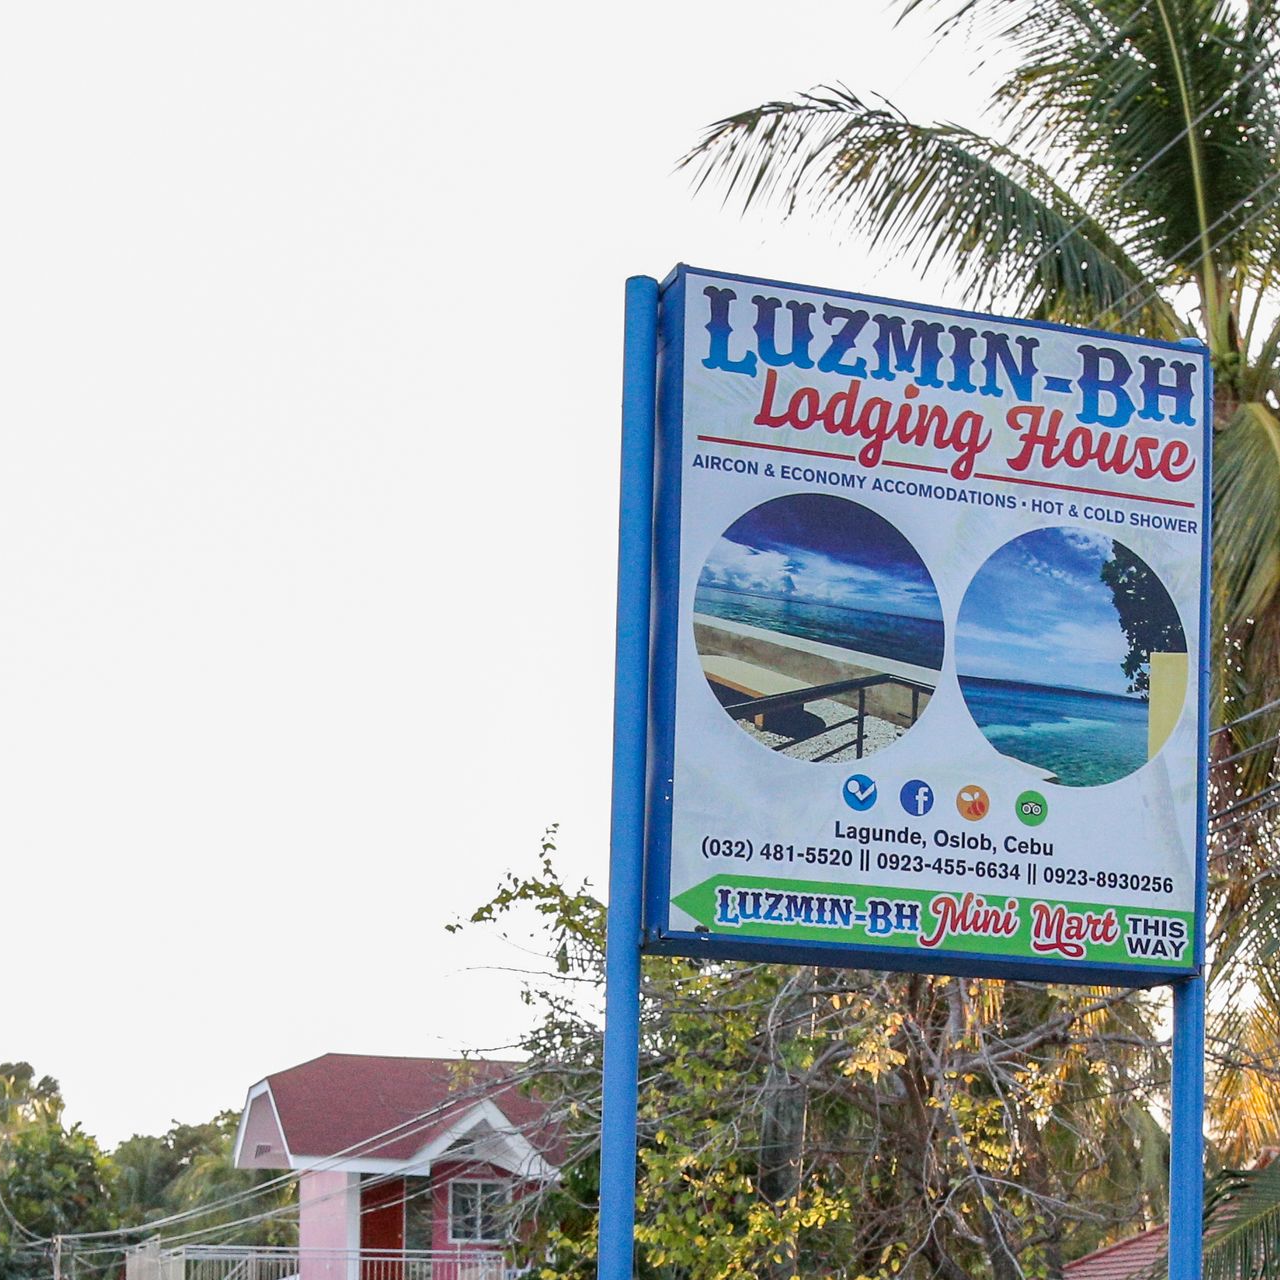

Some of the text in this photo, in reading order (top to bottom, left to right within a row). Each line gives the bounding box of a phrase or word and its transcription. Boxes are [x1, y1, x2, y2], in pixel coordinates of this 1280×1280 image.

[702, 286, 1197, 428] LUZMIN-BH
[753, 368, 1196, 482] Lodging House
[692, 454, 1198, 534] AIRCON & ECONOMY ACCOMODATIONS HOT & COLD SHOWER
[701, 836, 754, 861] (032)
[760, 843, 853, 866] 481-5520
[877, 853, 1020, 880] 0923-455-6634
[1043, 867, 1173, 893] 0923-8930256
[835, 821, 1054, 856] Lagunde, Oslob, Cebu
[718, 889, 1118, 957] LUZMIN-BH Mini Mart
[1127, 937, 1186, 957] WAY
[1128, 917, 1185, 938] THIS
